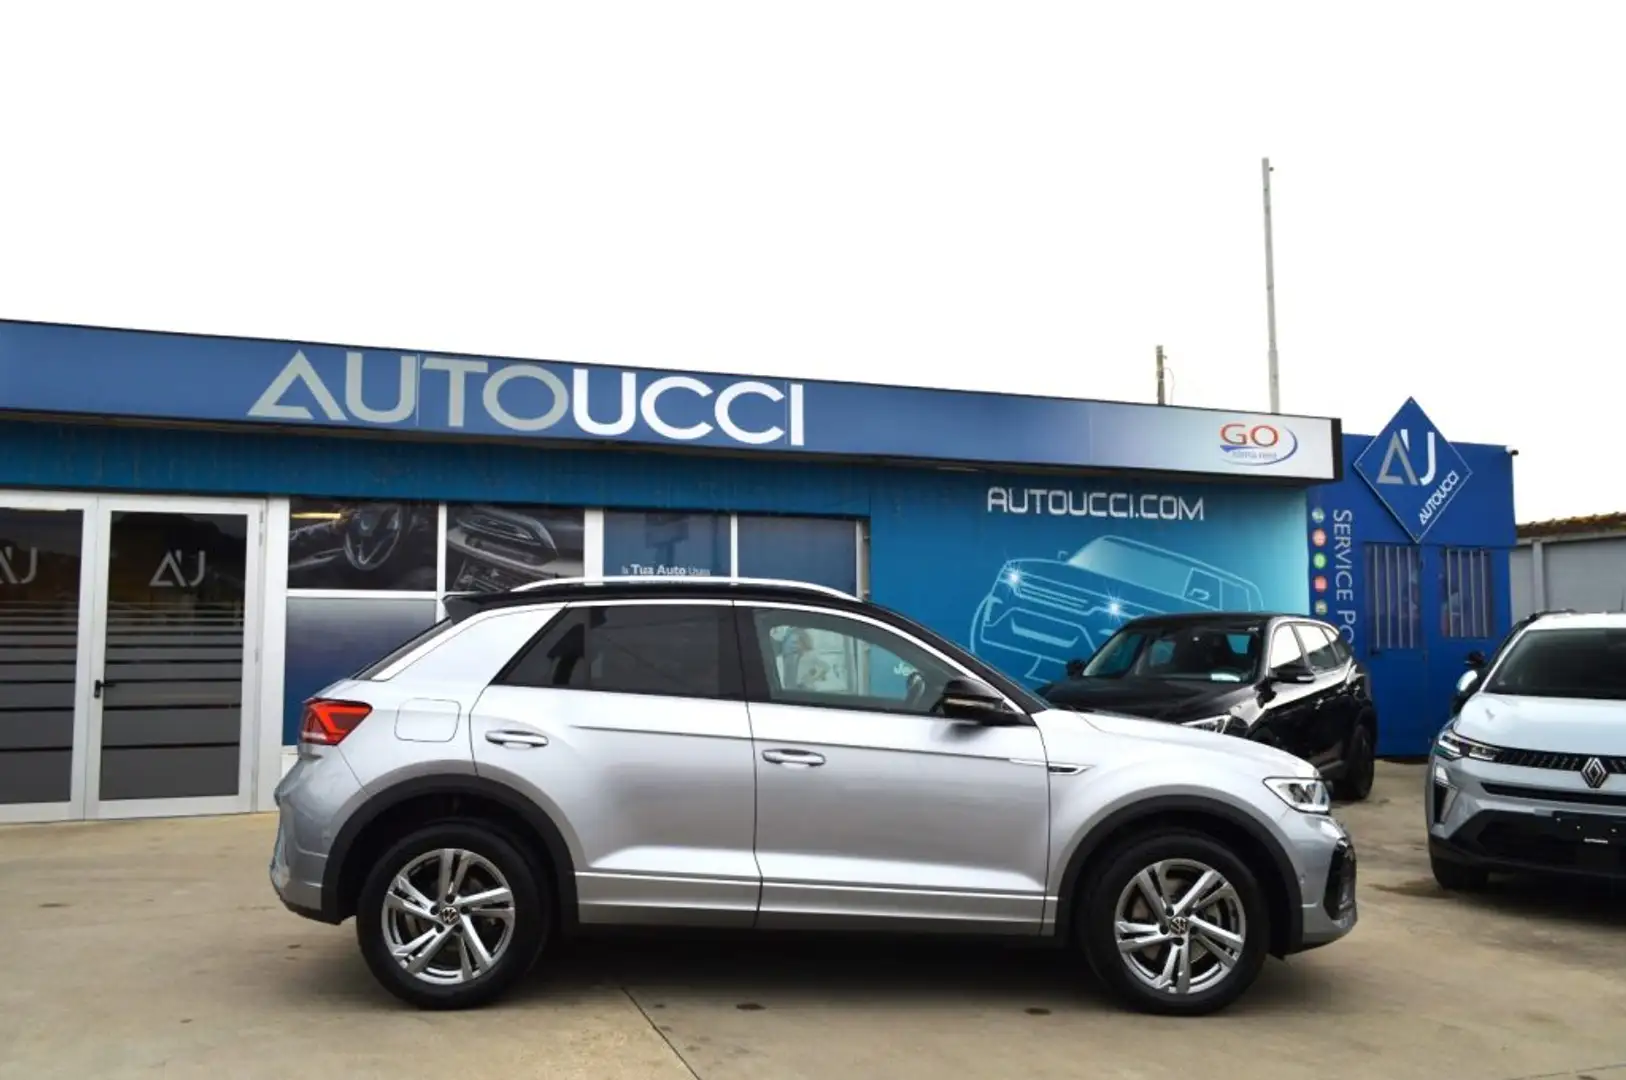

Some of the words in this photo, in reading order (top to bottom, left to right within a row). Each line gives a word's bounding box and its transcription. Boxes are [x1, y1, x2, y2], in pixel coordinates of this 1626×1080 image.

[246, 350, 805, 447] AUTOUCCI
[1220, 423, 1278, 447] GO
[987, 487, 1204, 521] AUTOUCCI.COM
[1418, 470, 1459, 525] AUTOUCCI
[630, 563, 654, 575] Tua
[657, 564, 686, 576] Auto
[1333, 509, 1353, 601] SERVICE
